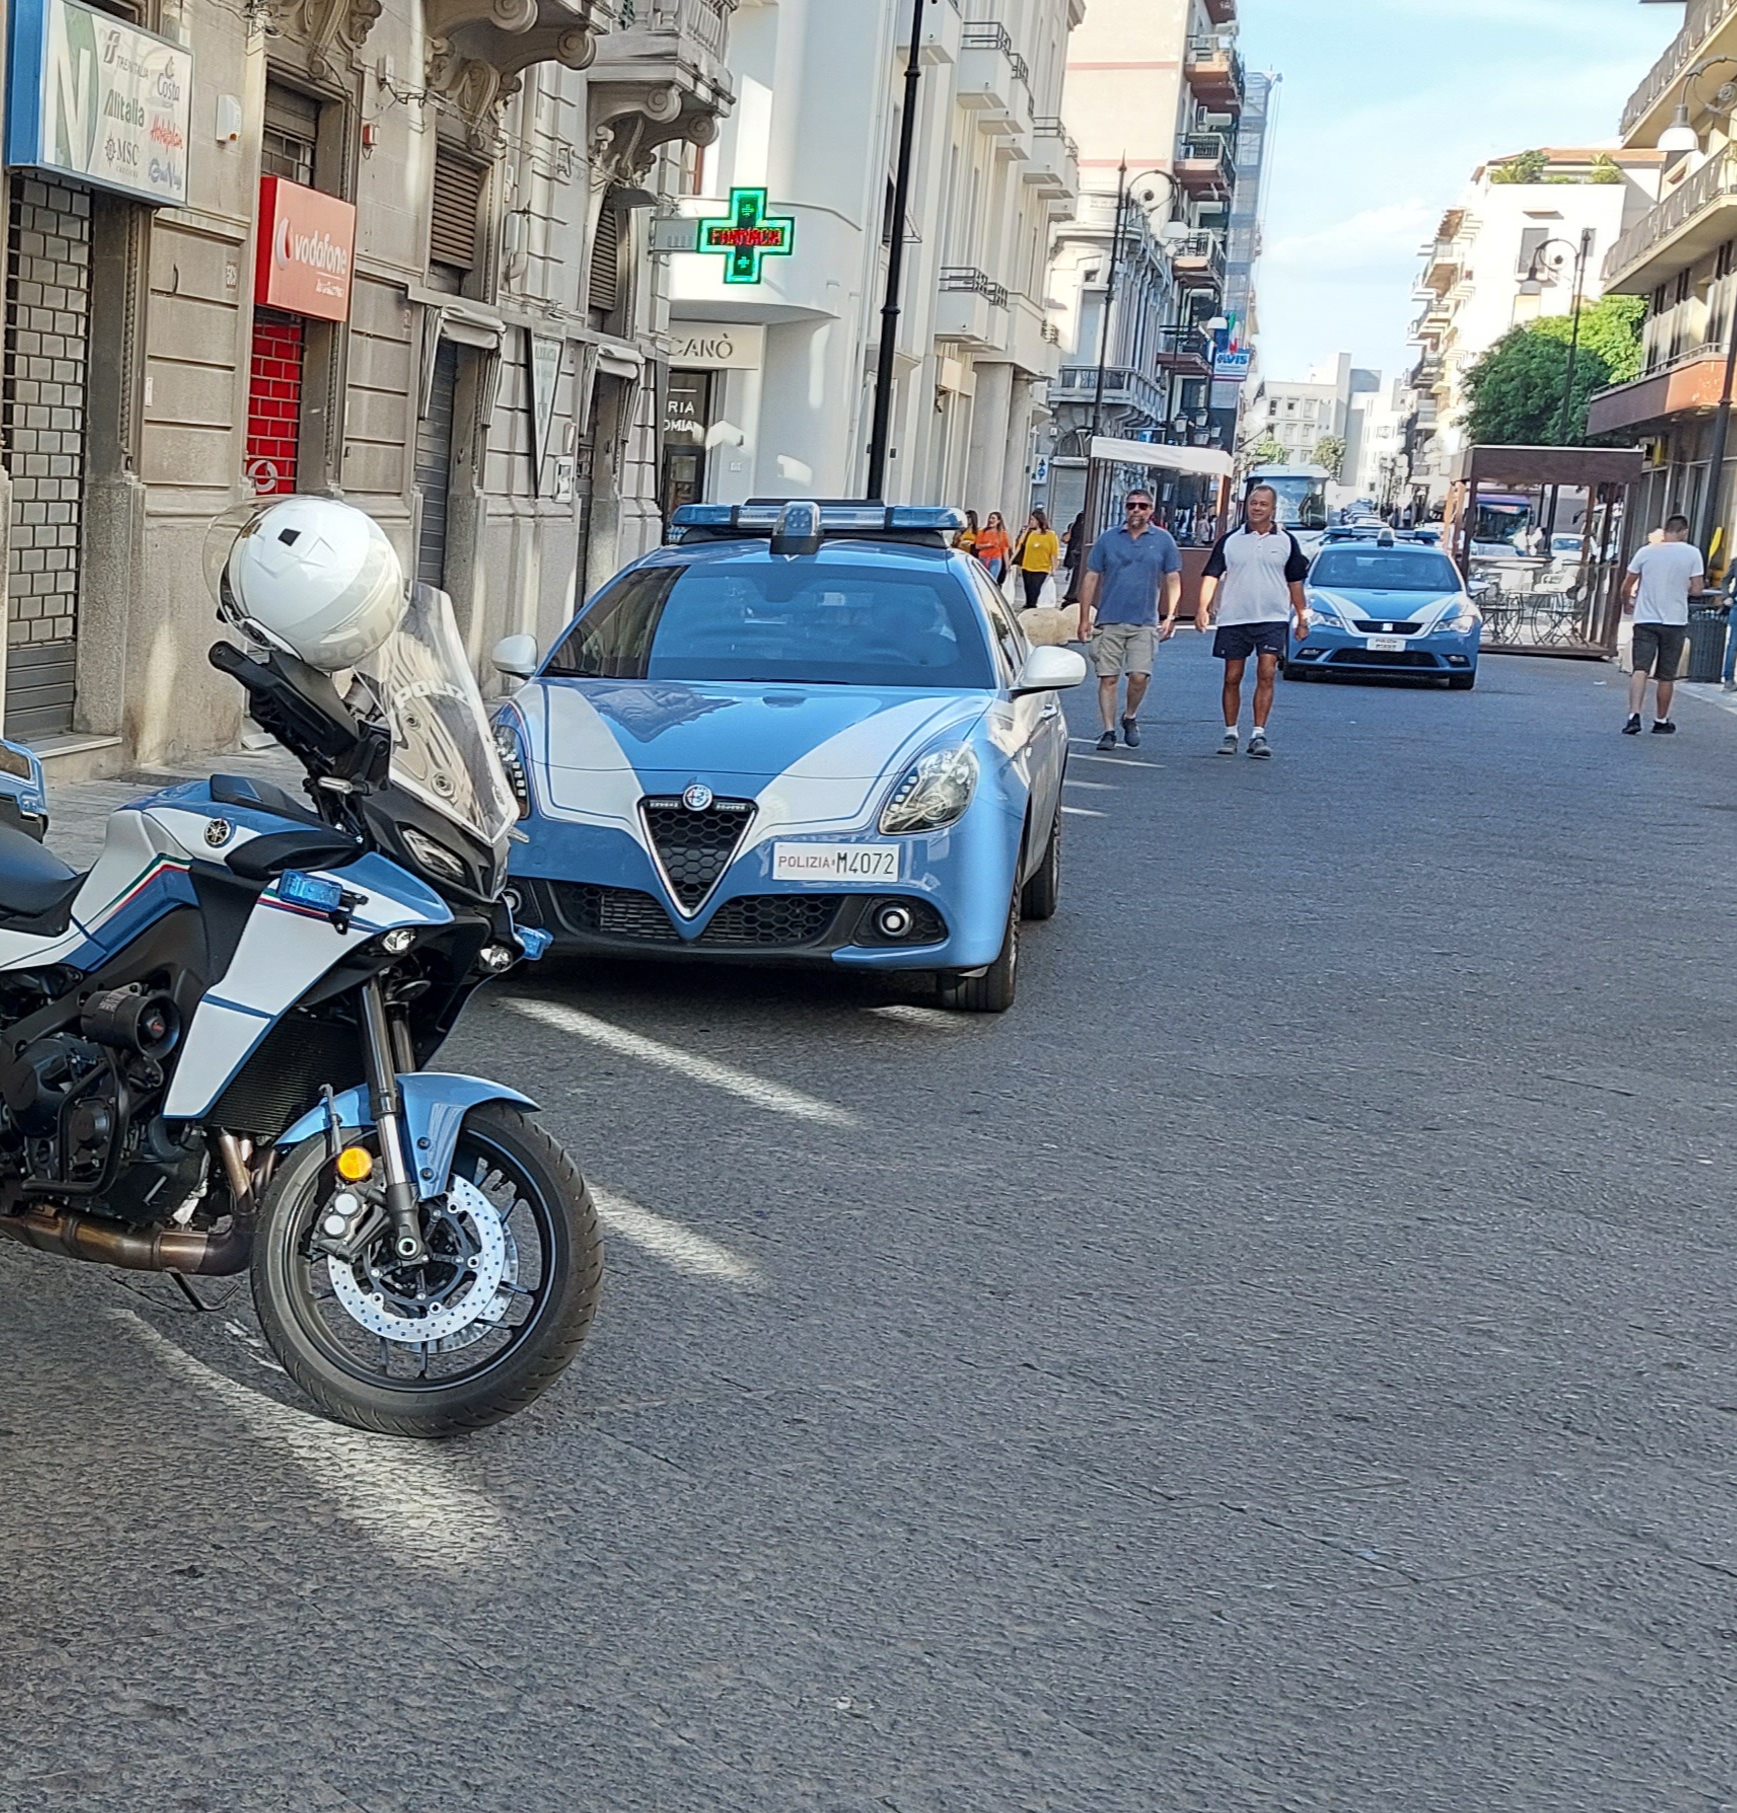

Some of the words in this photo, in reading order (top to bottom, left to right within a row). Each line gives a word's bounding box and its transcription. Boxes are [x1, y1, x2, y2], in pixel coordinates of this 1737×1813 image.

[157, 73, 180, 102] Costa
[104, 88, 145, 128] Alitalia
[117, 138, 140, 166] MSC
[295, 229, 348, 275] vodafone
[778, 855, 830, 869] POLIZIA
[836, 852, 895, 875] M4072
